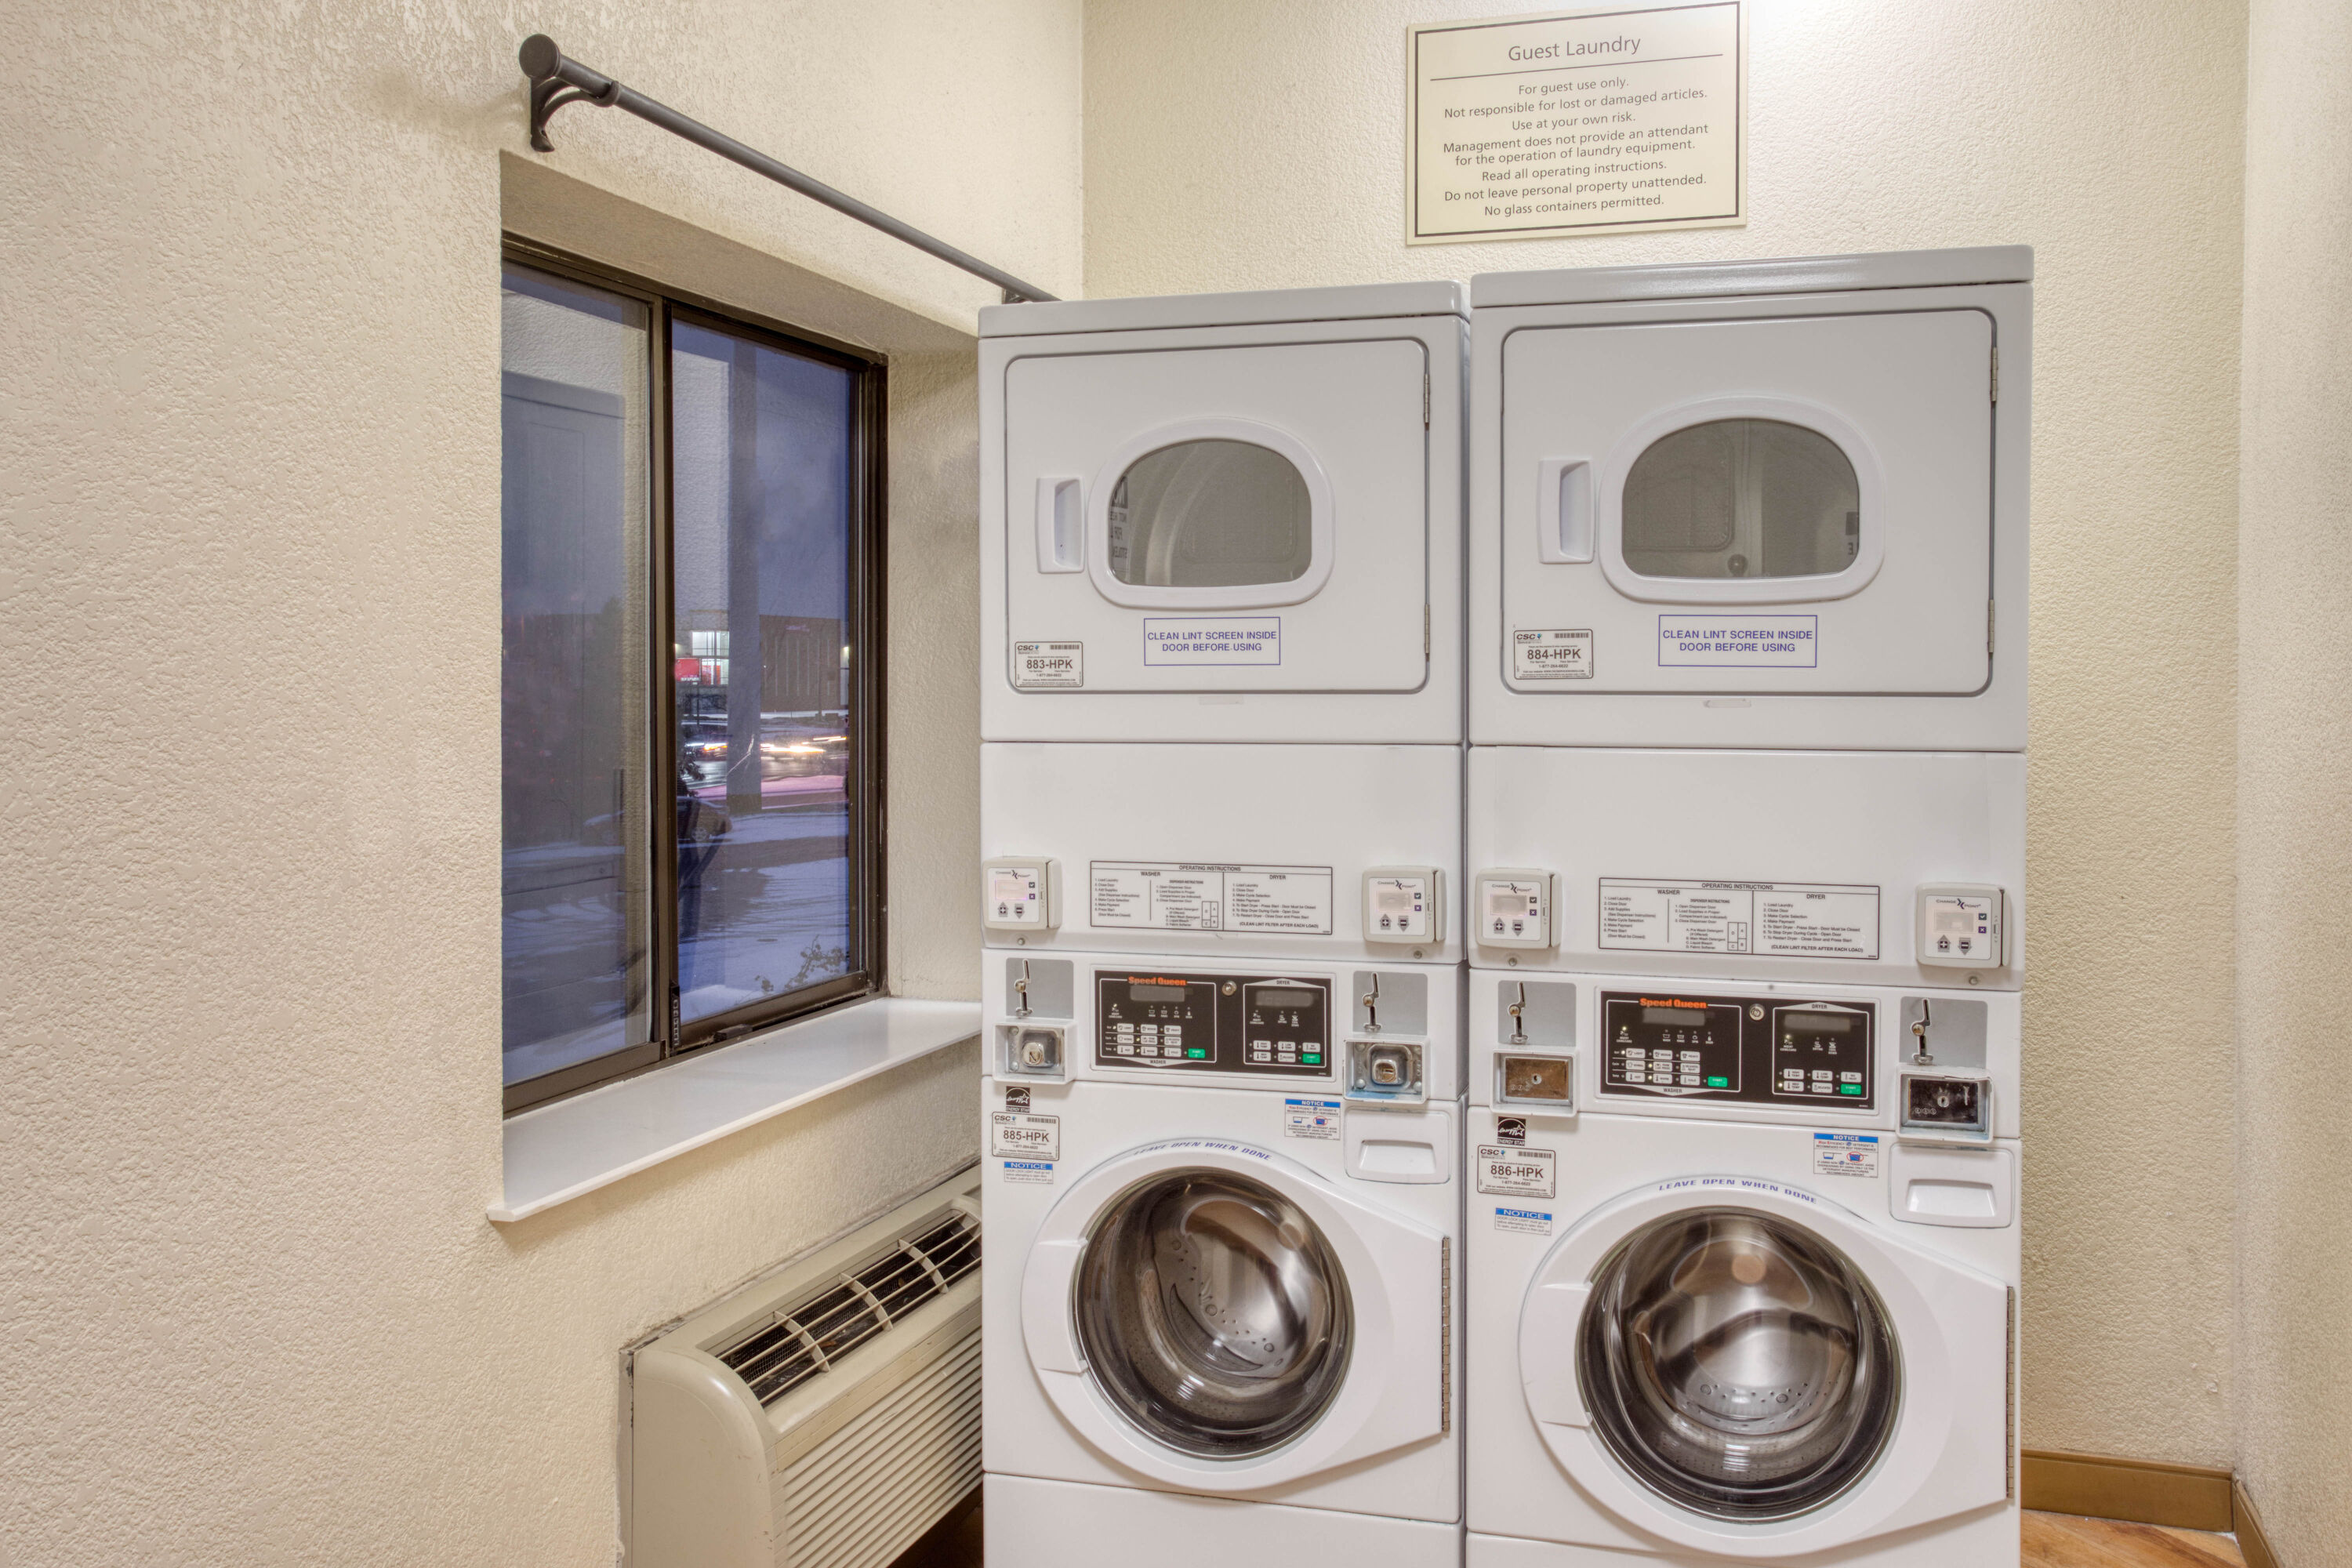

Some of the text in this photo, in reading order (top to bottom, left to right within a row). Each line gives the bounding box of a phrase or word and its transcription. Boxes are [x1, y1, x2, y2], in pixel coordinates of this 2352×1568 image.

[1508, 35, 1641, 61] Guest Laundry
[1519, 76, 1629, 96] For guest use only.
[1444, 88, 1707, 118] Not responsible for lost or damaged articles.
[1512, 111, 1636, 131] Use at your own risk.
[1443, 124, 1708, 154] Management does not provide an attendant
[1454, 140, 1695, 166] for the operation of laundry equipment.
[1482, 160, 1667, 182] Read all operating instructions.
[1444, 173, 1707, 201] Do not leave personal property unattended.
[1484, 194, 1664, 218] No glass containers permitted.
[1148, 630, 1277, 641] CLEAN LINT SCREEN INSIDE
[1663, 630, 1813, 640] CLEAN LINT SCREEN INSIDE
[1162, 642, 1262, 652] DOOR BEFORE USING
[1527, 648, 1581, 660] 884-HPK
[1679, 642, 1795, 652] DOOR BEFORE USING
[1026, 659, 1073, 670] 883-HPK
[1128, 976, 1187, 985] Speed Queen
[1639, 997, 1707, 1008] Speed Queen
[1003, 1129, 1050, 1142] 885-HPK
[1205, 1142, 1238, 1151] WHEN
[1242, 1148, 1272, 1160] DONE
[1010, 1162, 1047, 1171] NOTICE
[1490, 1164, 1544, 1179] 886-HPK
[1659, 1179, 1697, 1191] LEAVE
[1741, 1180, 1779, 1192] WHEN
[1784, 1189, 1817, 1204] DONE
[1502, 1209, 1545, 1220] NOTICE
